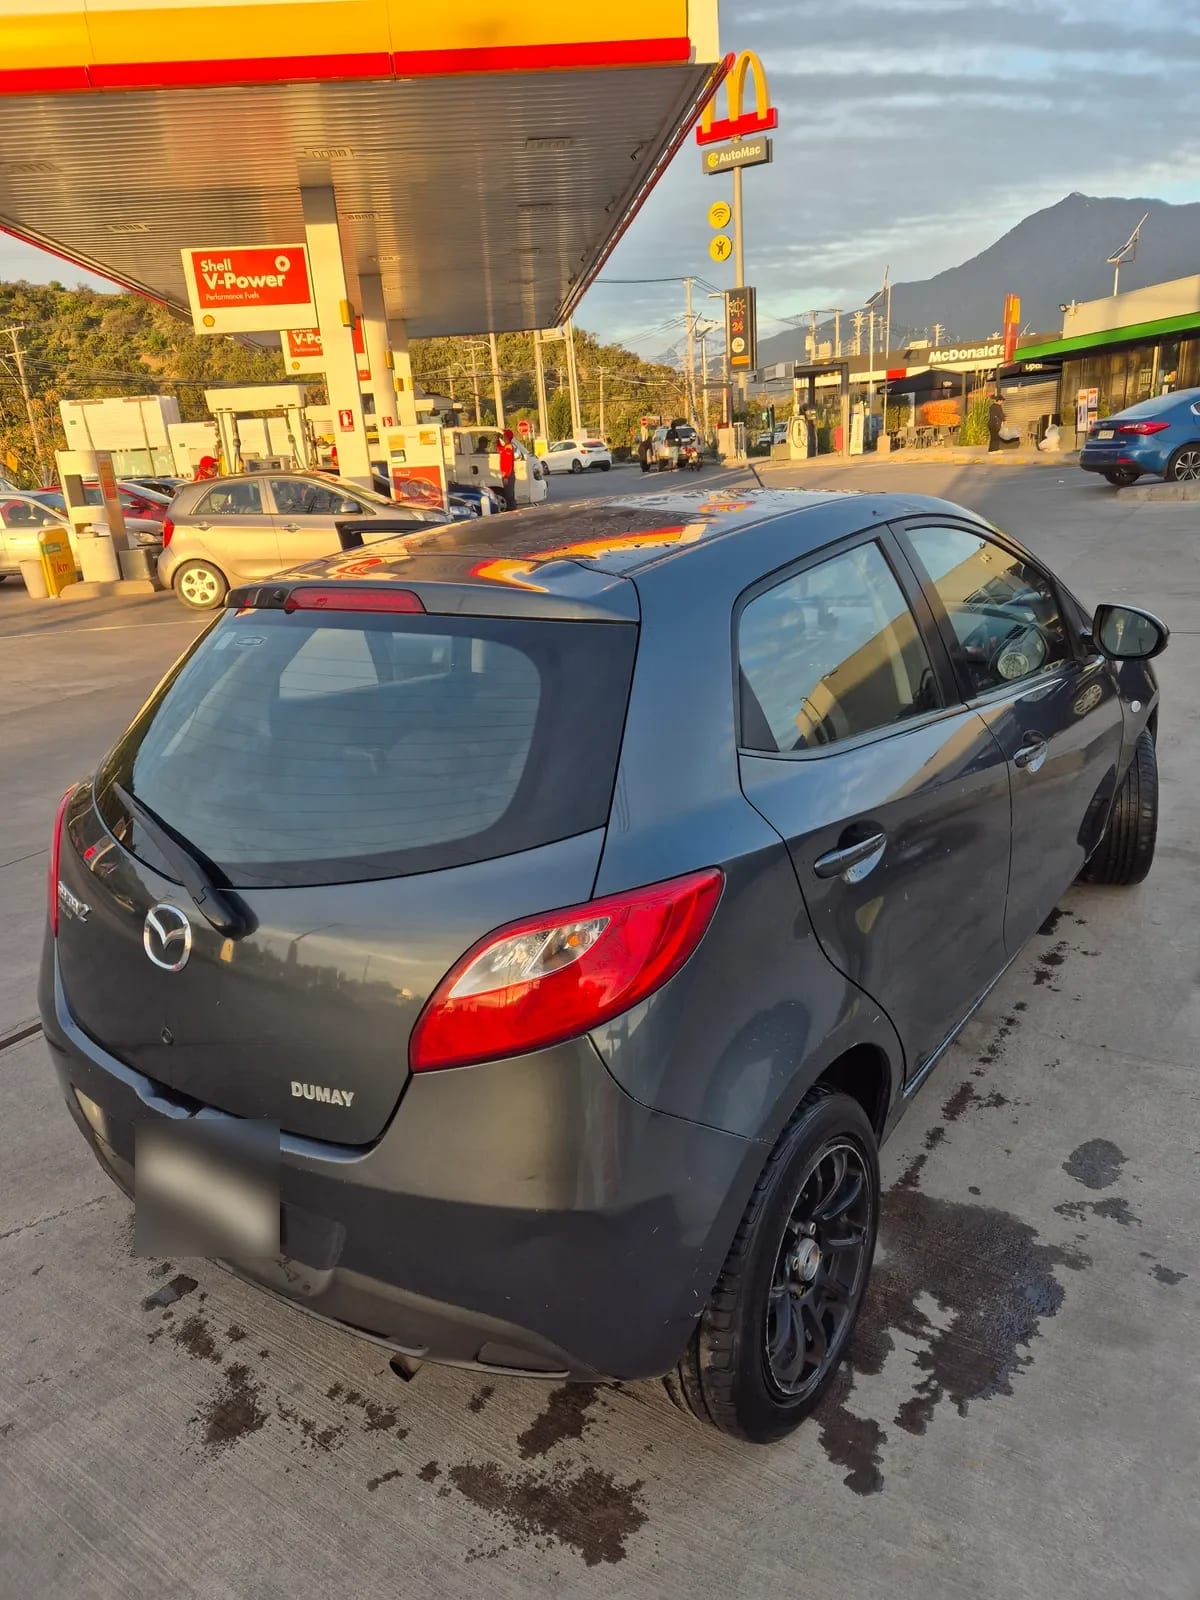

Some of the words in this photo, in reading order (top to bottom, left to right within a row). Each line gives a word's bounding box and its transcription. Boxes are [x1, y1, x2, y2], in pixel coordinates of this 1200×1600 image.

[719, 146, 761, 163] AutoMac
[201, 258, 232, 272] Shell
[202, 272, 286, 290] V-Power
[293, 333, 322, 345] V-Po
[928, 344, 1005, 363] McDonald's
[291, 1081, 354, 1107] DUMAY
